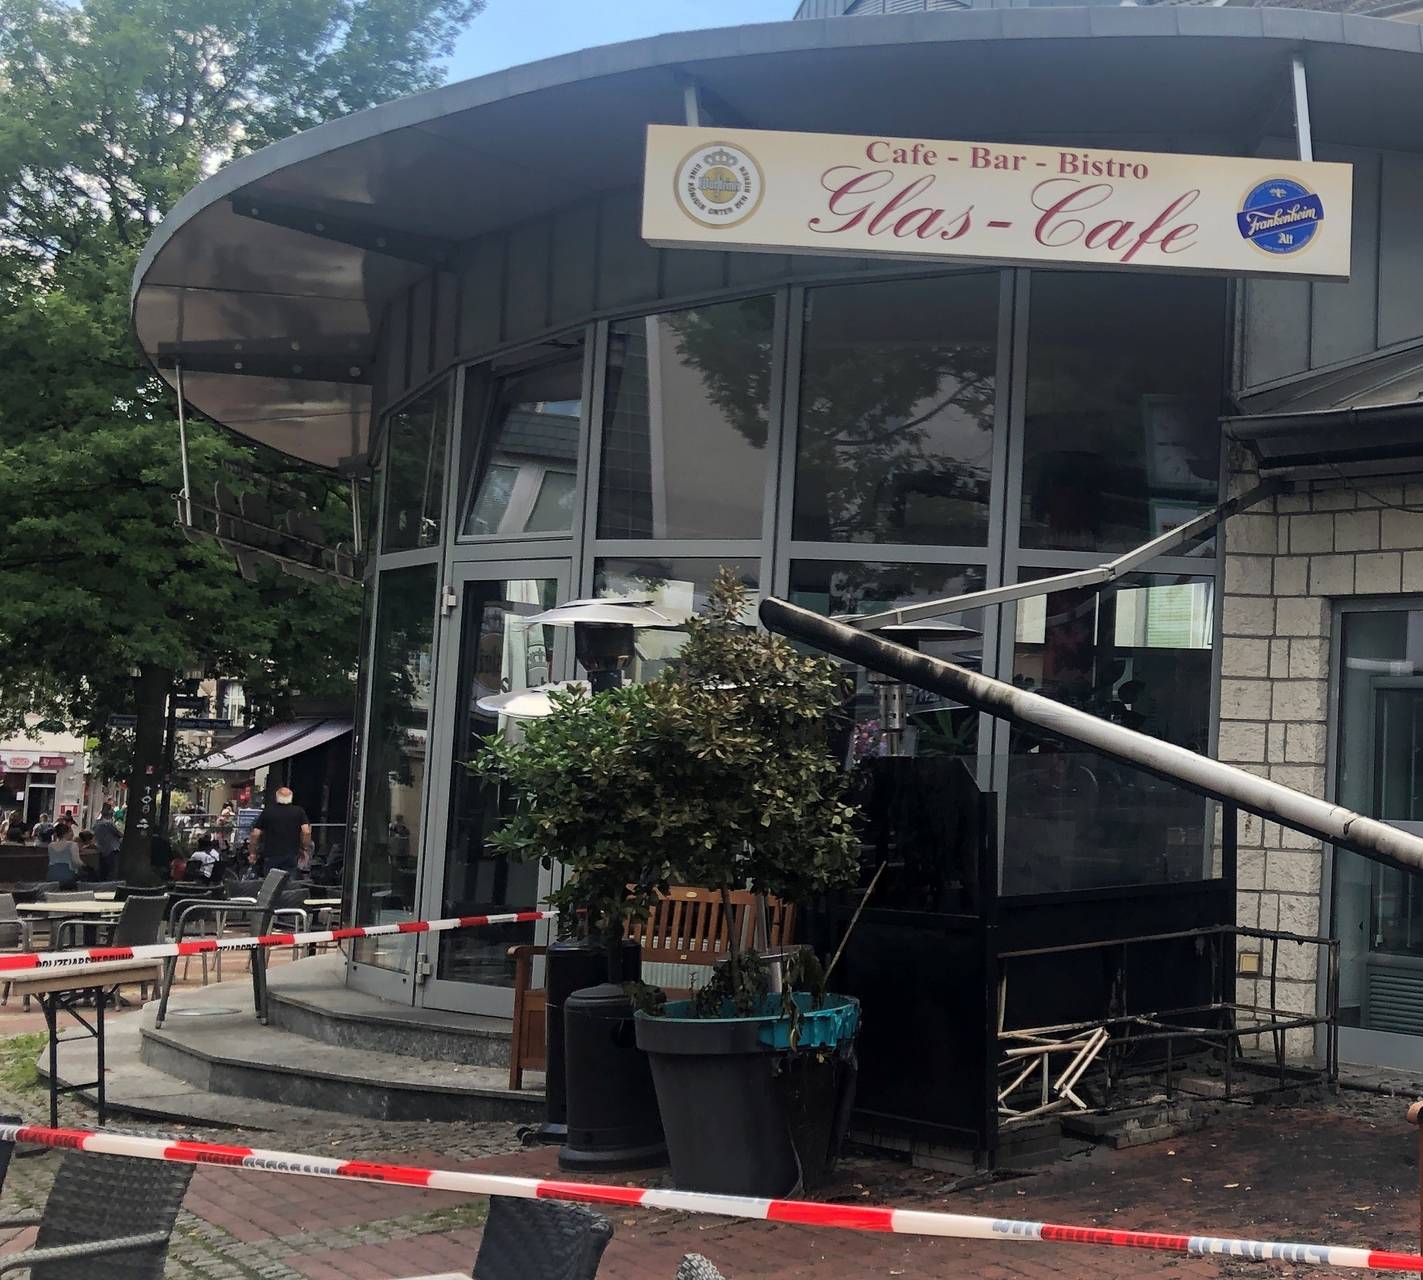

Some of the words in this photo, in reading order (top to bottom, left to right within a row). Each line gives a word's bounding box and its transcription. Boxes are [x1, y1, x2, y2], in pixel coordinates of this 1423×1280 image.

[866, 141, 938, 166] Cafe
[970, 146, 1027, 171] Bar
[1059, 152, 1149, 180] Bistro
[1246, 204, 1318, 236] Frankenheim
[1278, 232, 1294, 245] Alt
